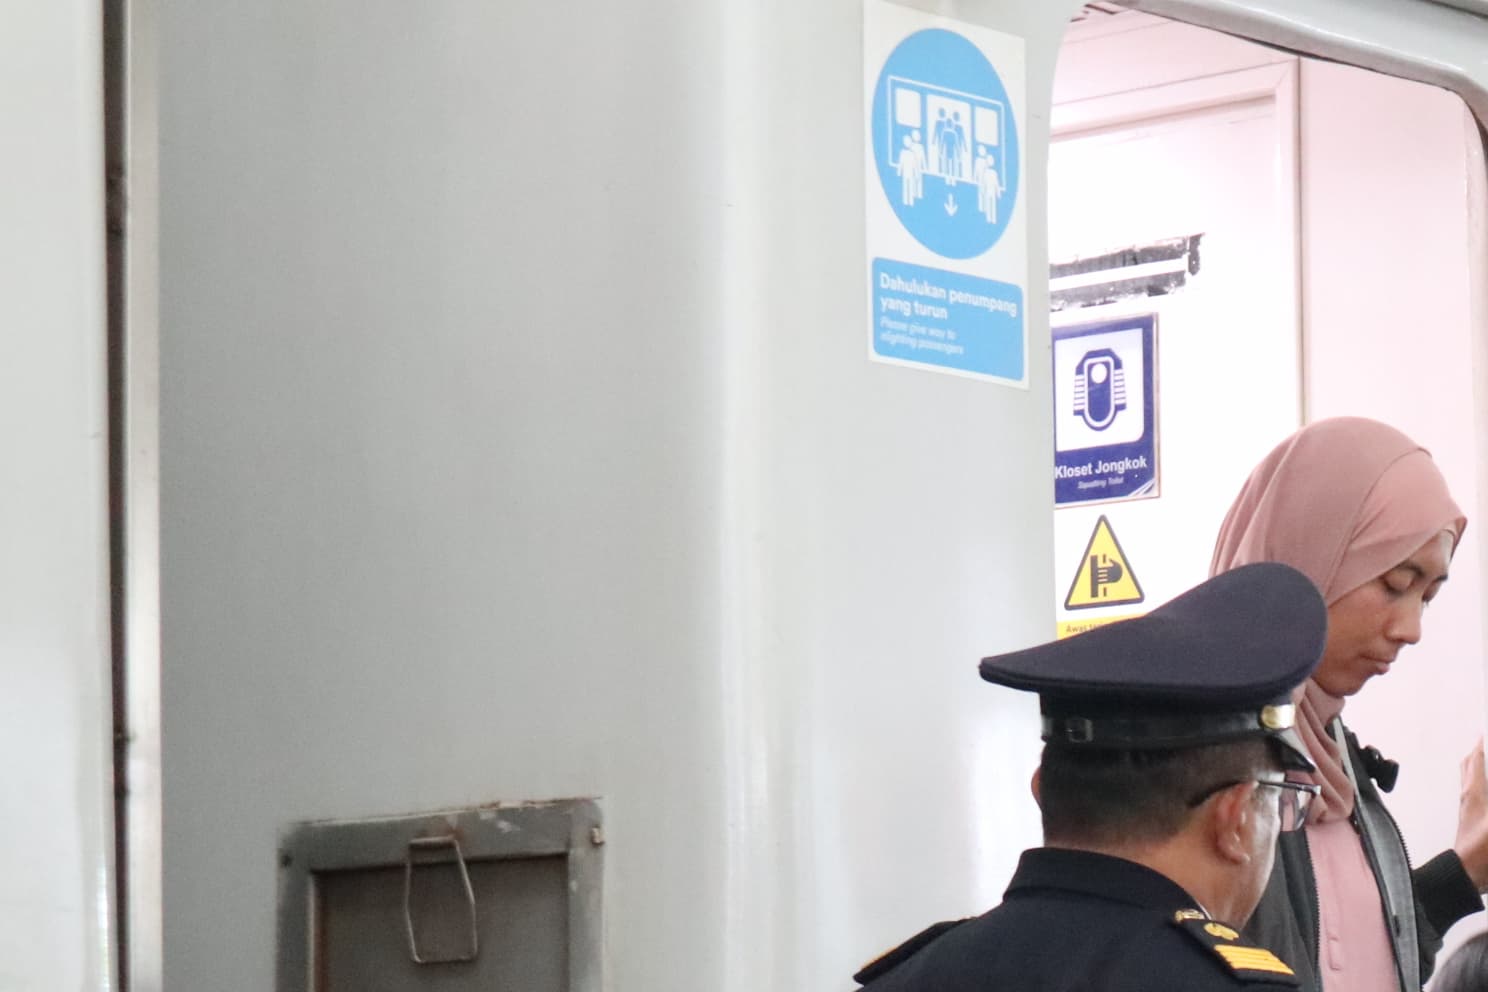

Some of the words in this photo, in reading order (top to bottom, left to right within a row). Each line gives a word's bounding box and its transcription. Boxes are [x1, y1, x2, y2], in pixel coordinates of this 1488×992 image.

[880, 272, 947, 299] Dahulukan
[949, 288, 1018, 318] penumpang
[880, 296, 912, 317] yang
[914, 299, 948, 320] turun
[1055, 462, 1093, 478] Kloset
[1094, 455, 1148, 474] Jongkok
